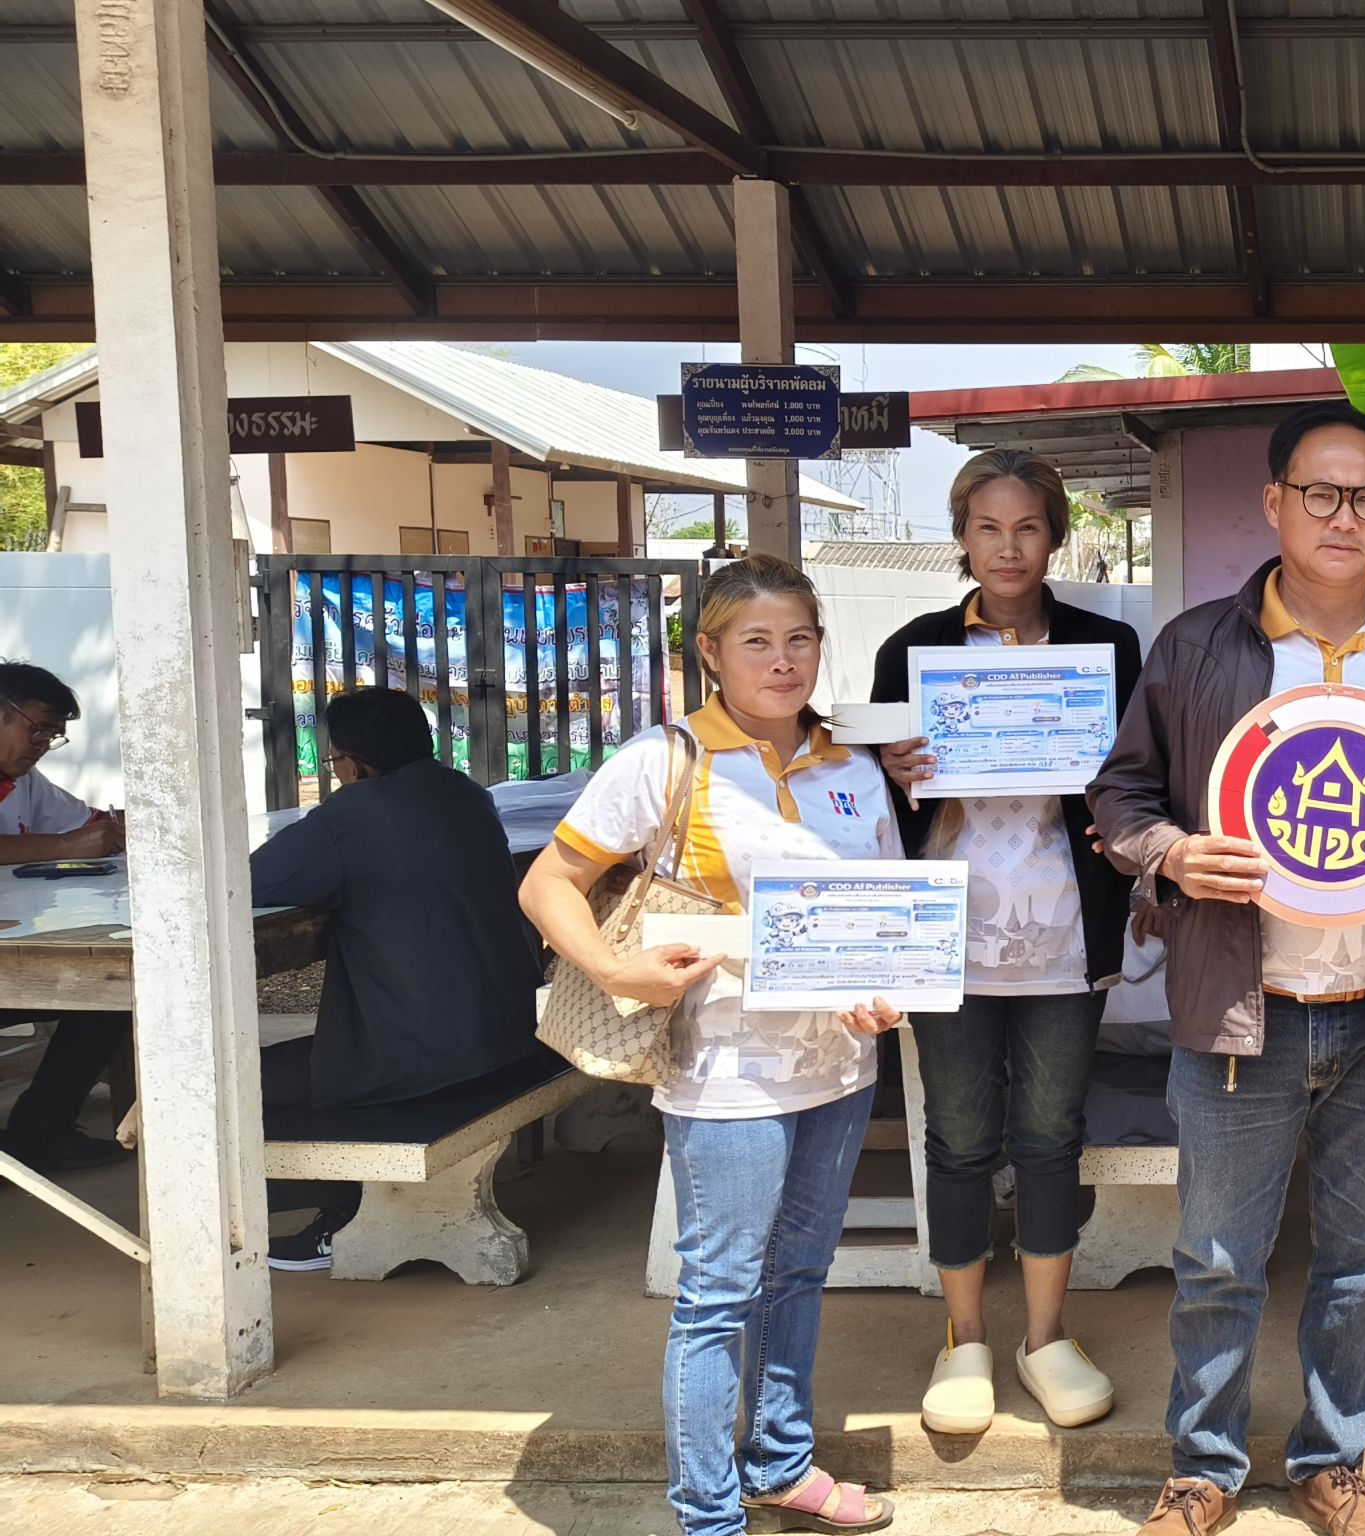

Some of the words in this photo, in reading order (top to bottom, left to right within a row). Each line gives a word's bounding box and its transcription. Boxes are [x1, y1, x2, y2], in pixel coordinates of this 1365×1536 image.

[1020, 672, 1062, 680] Publisher
[853, 882, 866, 890] AI
[868, 882, 912, 891] Publisher
